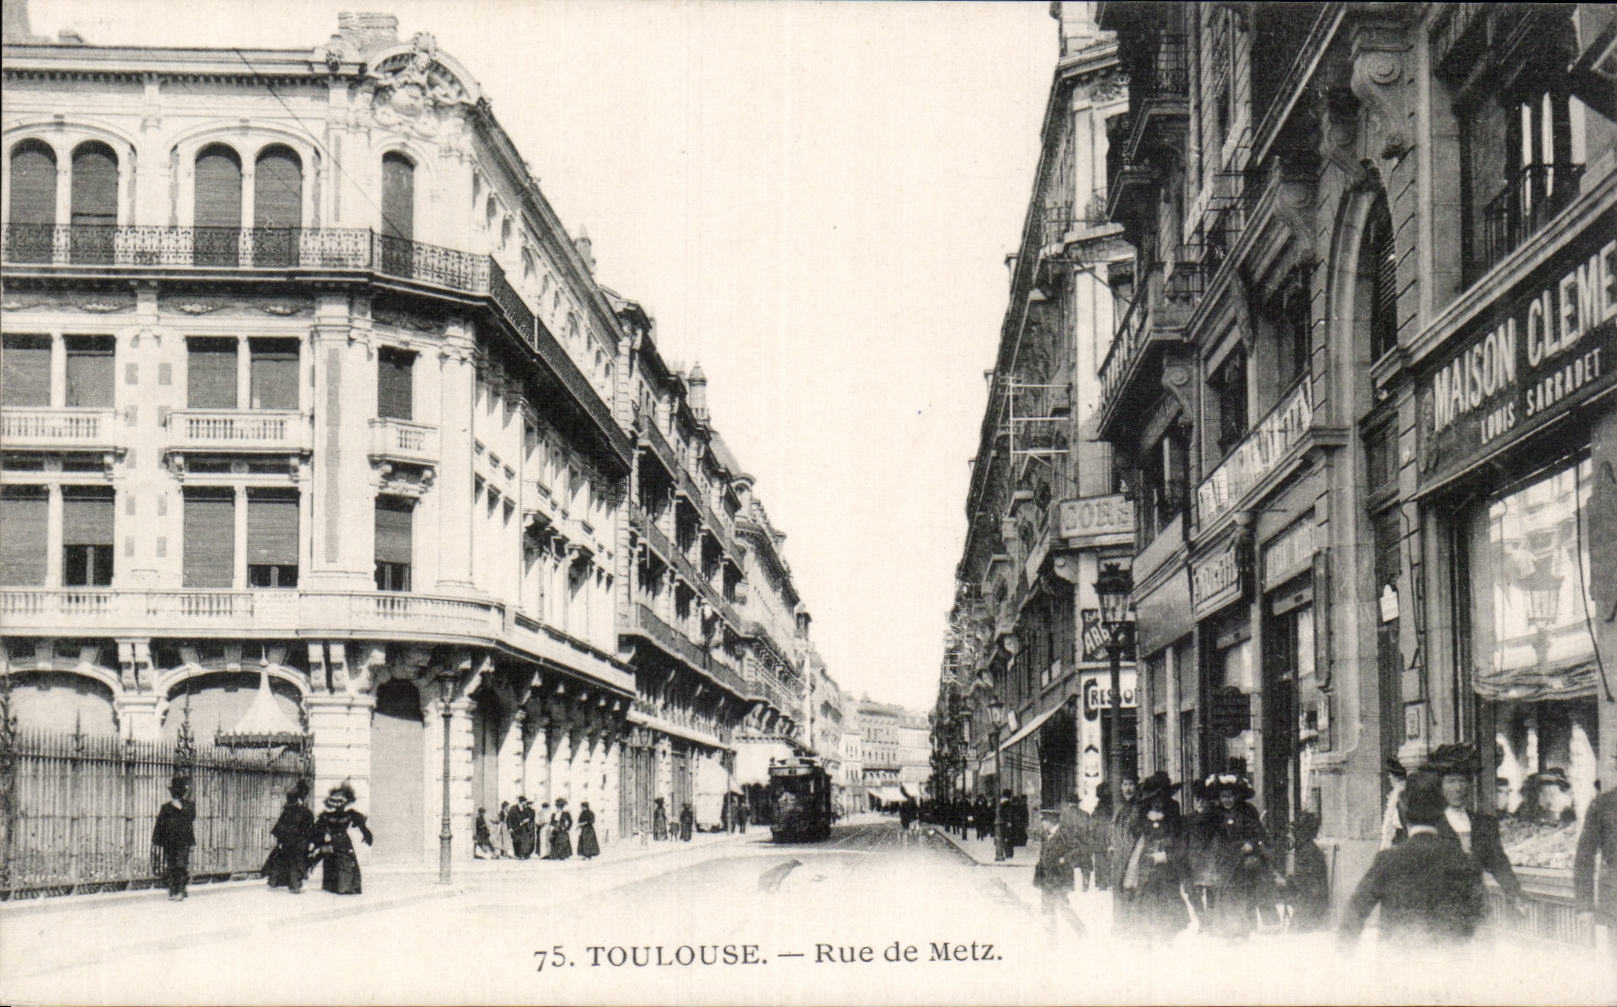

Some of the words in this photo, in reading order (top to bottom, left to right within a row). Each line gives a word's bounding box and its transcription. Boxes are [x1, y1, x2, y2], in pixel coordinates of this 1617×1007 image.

[1434, 317, 1517, 433] MAISON
[1481, 402, 1515, 445] LOUIS
[1527, 348, 1601, 417] SARRADET
